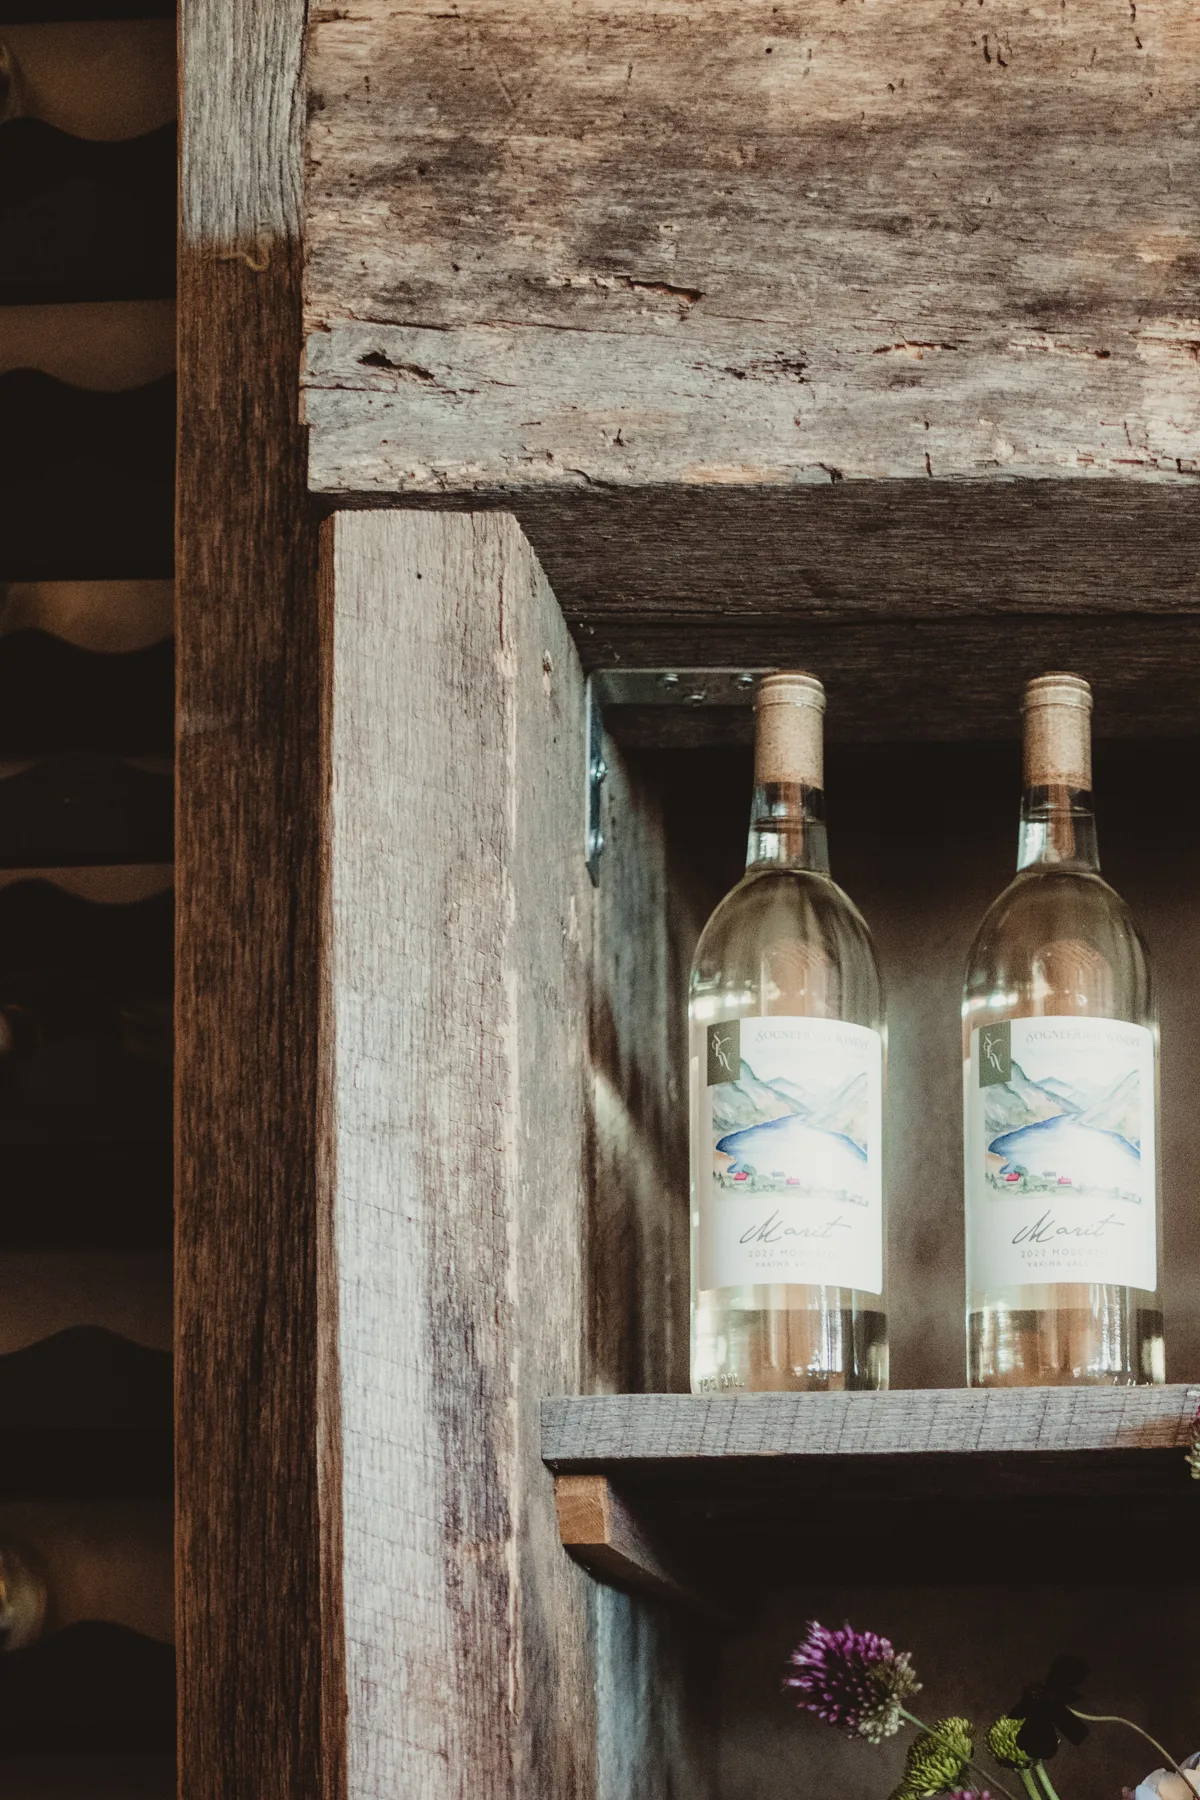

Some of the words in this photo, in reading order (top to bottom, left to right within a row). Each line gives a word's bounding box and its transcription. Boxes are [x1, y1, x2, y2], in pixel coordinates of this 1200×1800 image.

[739, 1209, 852, 1244] Marit
[1011, 1209, 1125, 1245] Marit
[748, 1249, 775, 1259] 2022
[780, 1249, 837, 1260] MOSTO
[1020, 1250, 1047, 1259] 2022
[1027, 1260, 1062, 1268] YAKIMA
[1066, 1259, 1102, 1268] VALL
